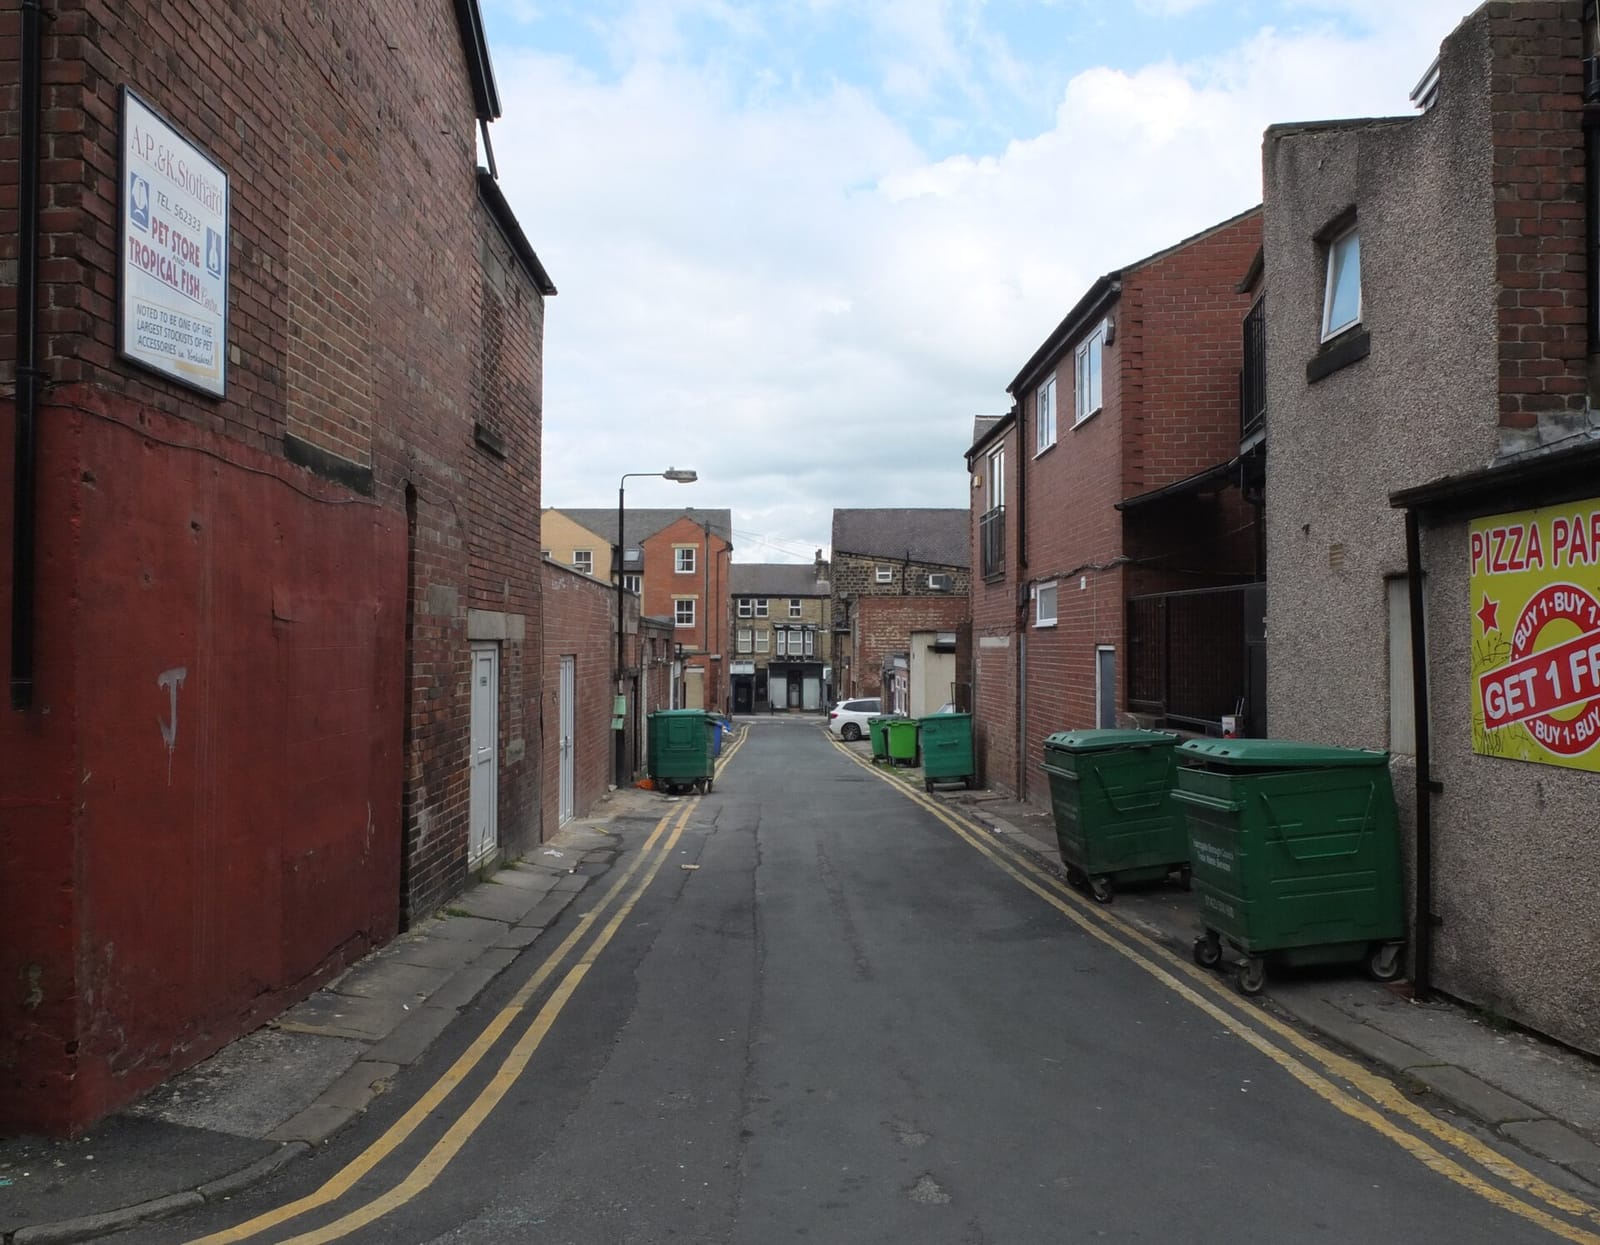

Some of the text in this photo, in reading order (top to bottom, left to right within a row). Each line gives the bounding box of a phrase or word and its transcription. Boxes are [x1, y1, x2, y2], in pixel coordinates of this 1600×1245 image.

[151, 216, 200, 268] PET STORE
[172, 255, 185, 267] AND
[129, 236, 200, 300] TROPICAL FISH
[136, 303, 212, 338] NOTED TO BE ONE OF THE
[136, 319, 162, 338] LARGEST
[194, 338, 201, 348] OF
[203, 341, 213, 352] PET
[137, 335, 176, 356] ACCESSORIES
[1471, 523, 1544, 576] PIZZA
[1514, 604, 1539, 651] BUY
[1553, 591, 1586, 616] BUY
[1484, 666, 1538, 721] GET
[1545, 659, 1562, 700] 1
[1535, 719, 1561, 746] BUY
